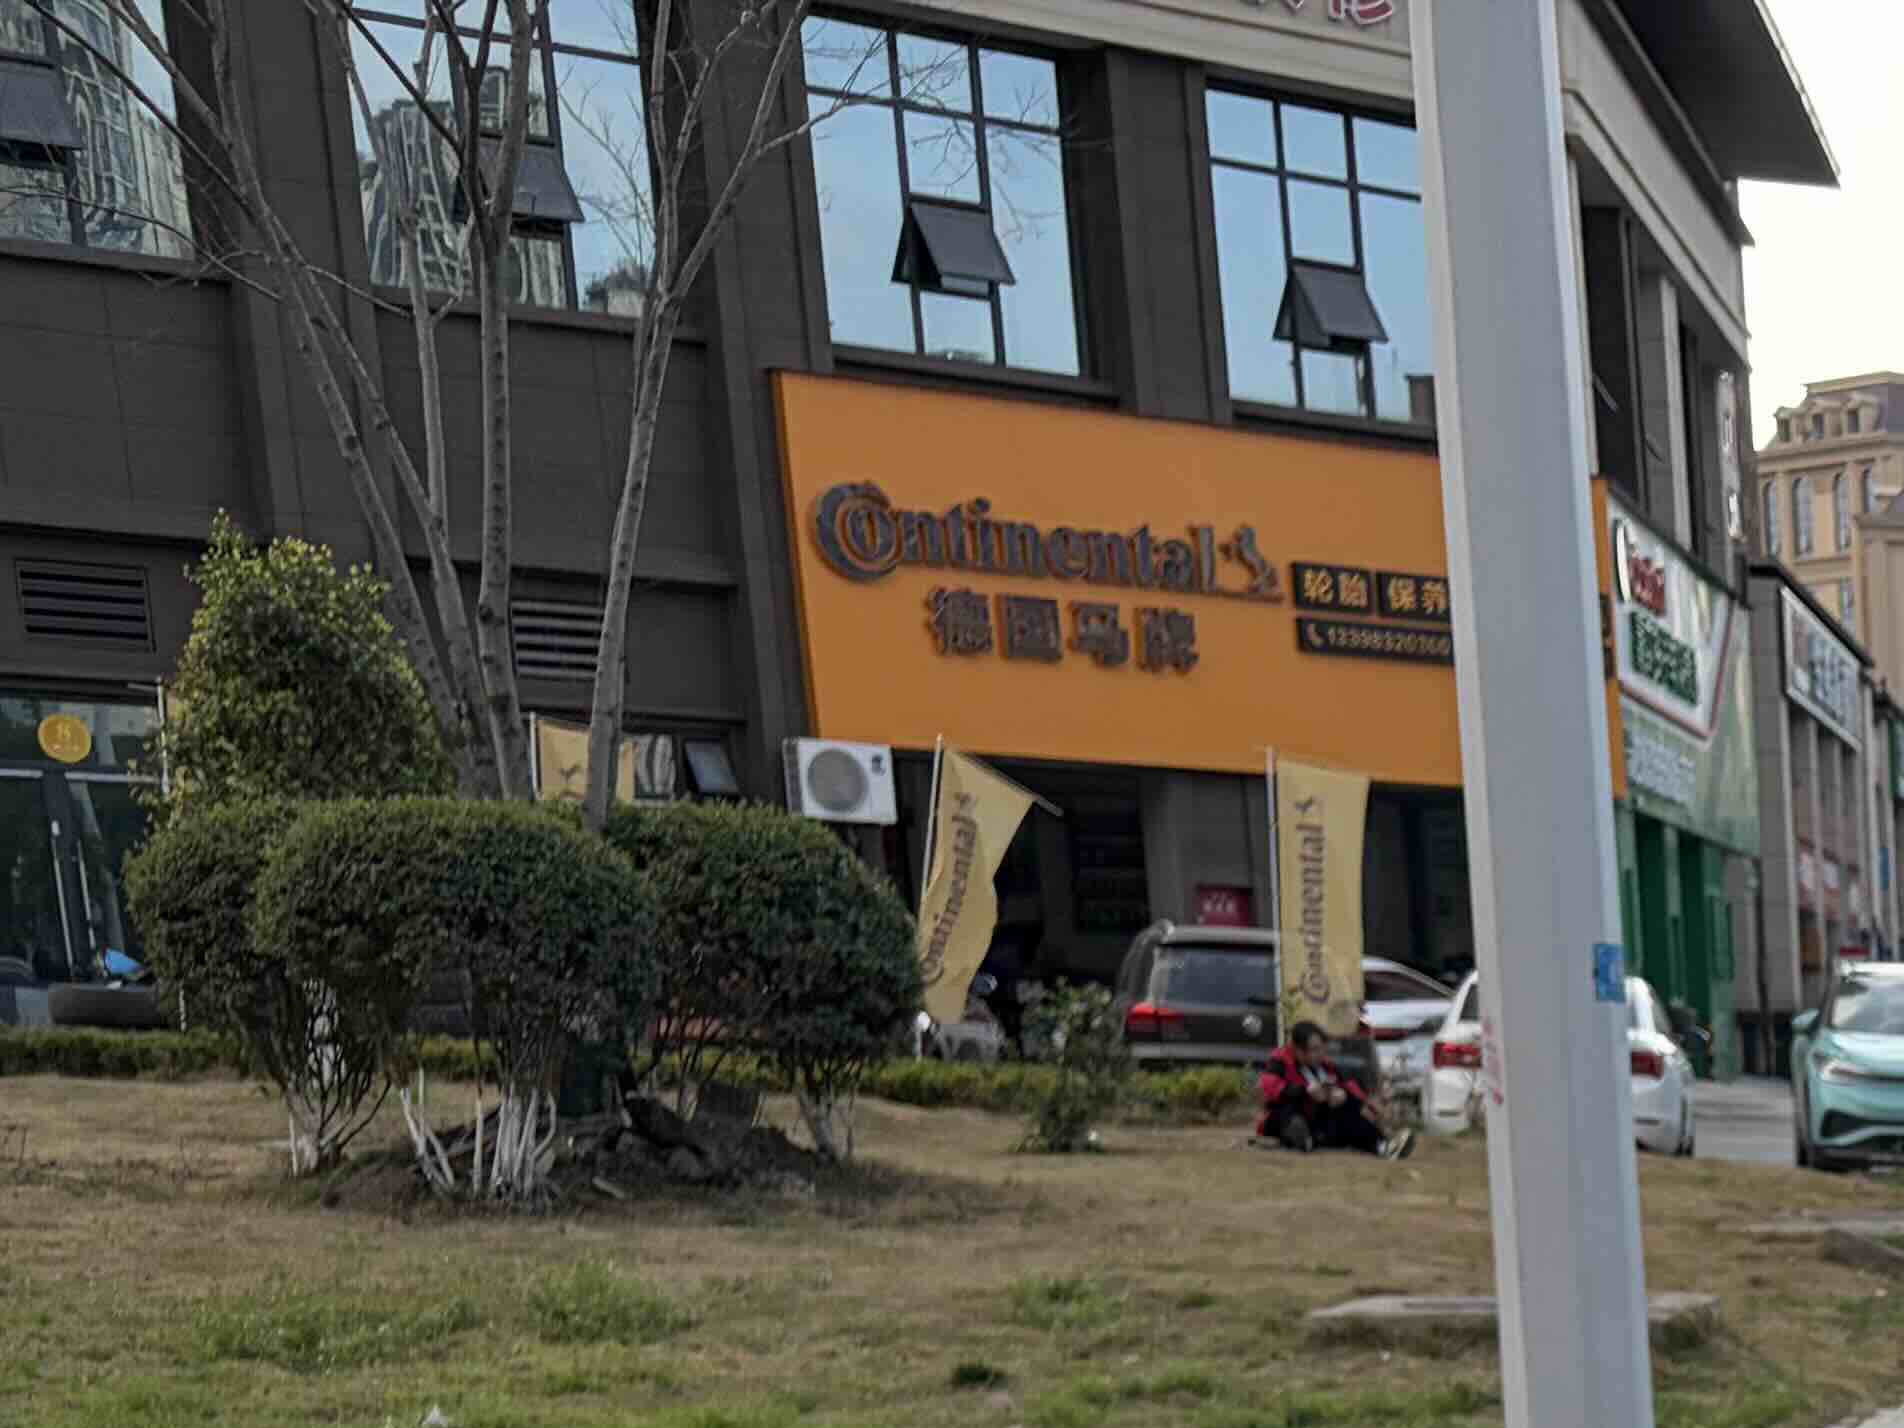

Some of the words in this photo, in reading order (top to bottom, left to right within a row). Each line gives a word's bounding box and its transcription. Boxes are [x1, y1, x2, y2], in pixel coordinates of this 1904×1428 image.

[815, 480, 1216, 594] Continental
[1303, 568, 1369, 608] 轮胎
[927, 585, 1200, 675] 德国马牌
[1296, 821, 1331, 1005] Continental
